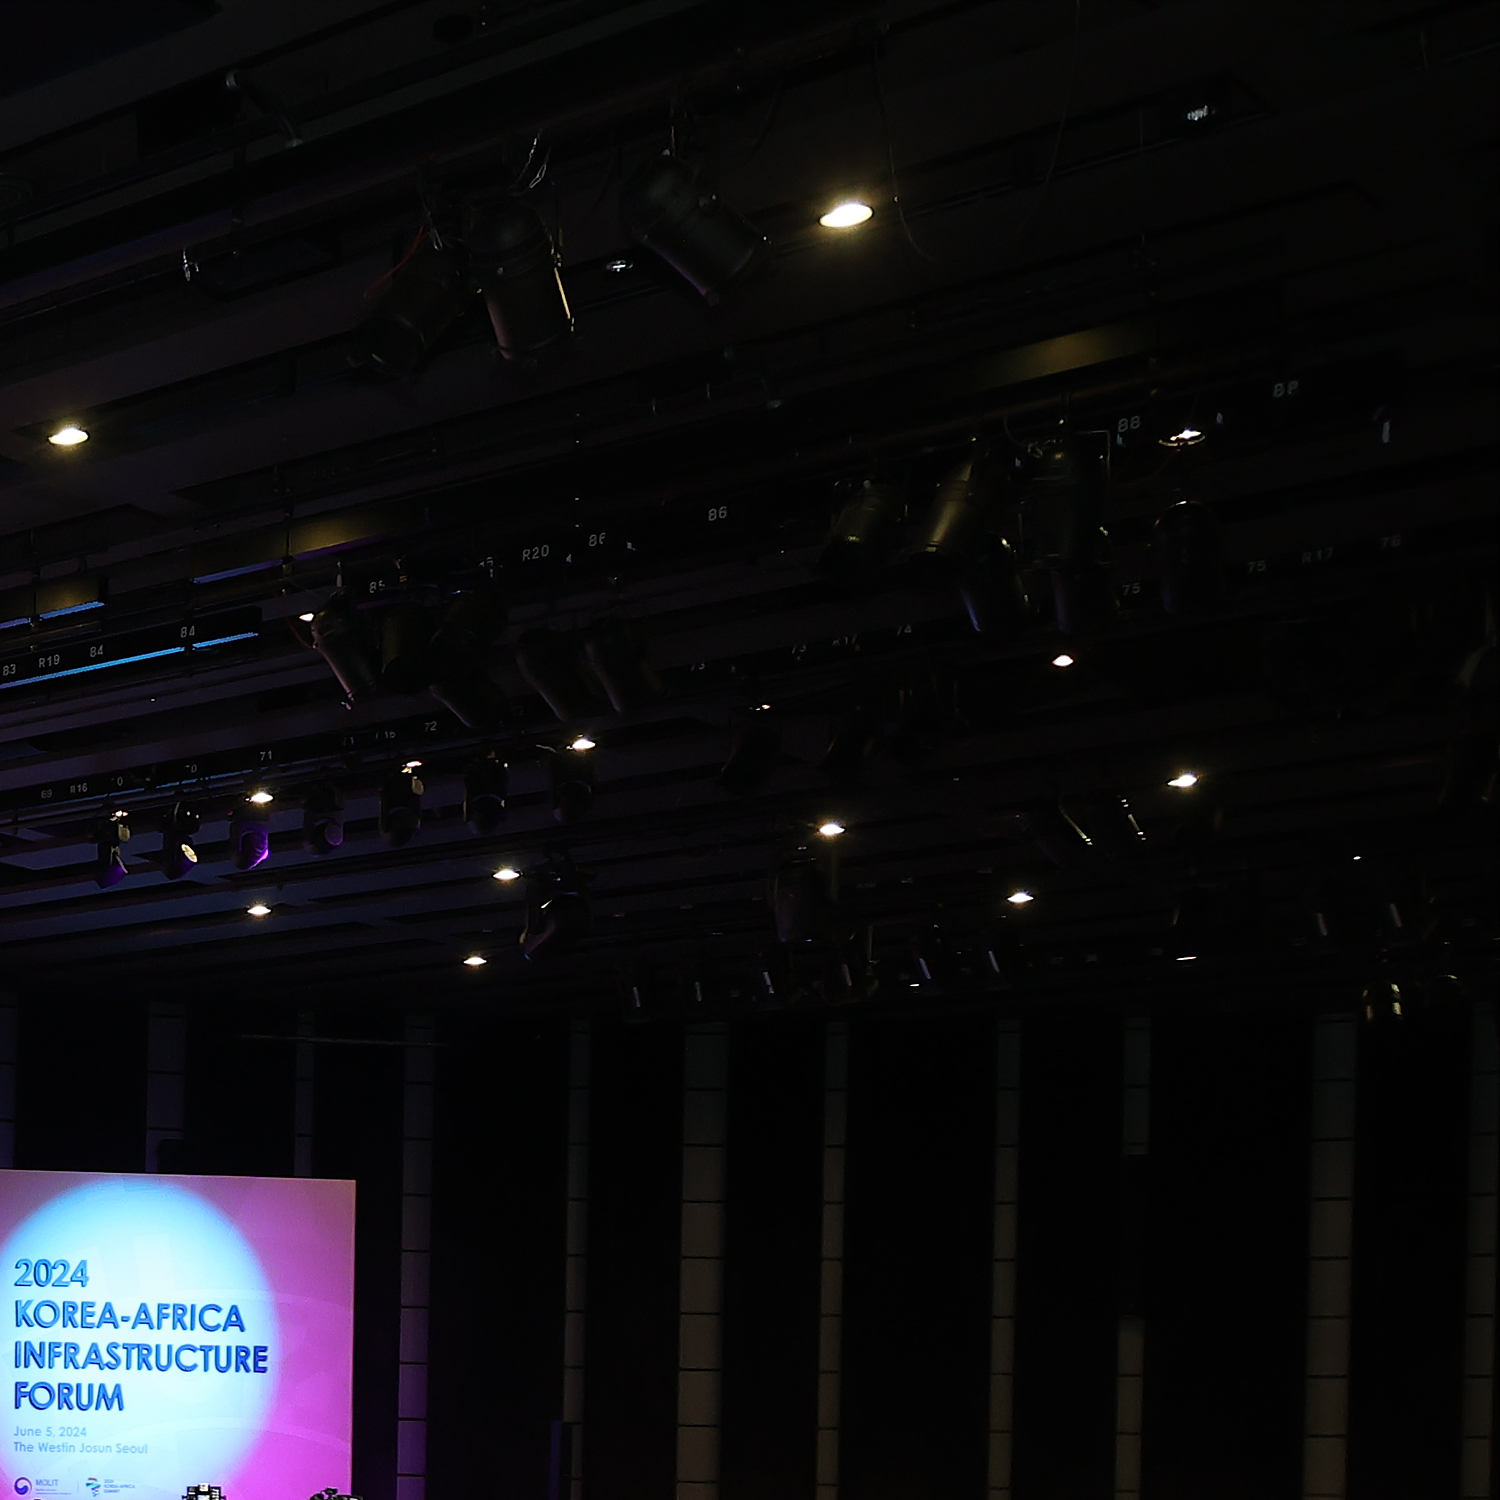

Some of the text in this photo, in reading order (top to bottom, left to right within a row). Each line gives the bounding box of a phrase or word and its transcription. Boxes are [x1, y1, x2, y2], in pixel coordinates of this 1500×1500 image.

[14, 1258, 89, 1287] 2024
[14, 1300, 246, 1332] KOREA-AFRICA
[14, 1341, 268, 1373] INFRASTRUCTURE
[14, 1382, 124, 1411] FORUM
[13, 1426, 42, 1437] June
[58, 1426, 87, 1437] 2024
[13, 1441, 148, 1454] The Westin Josun Seoul
